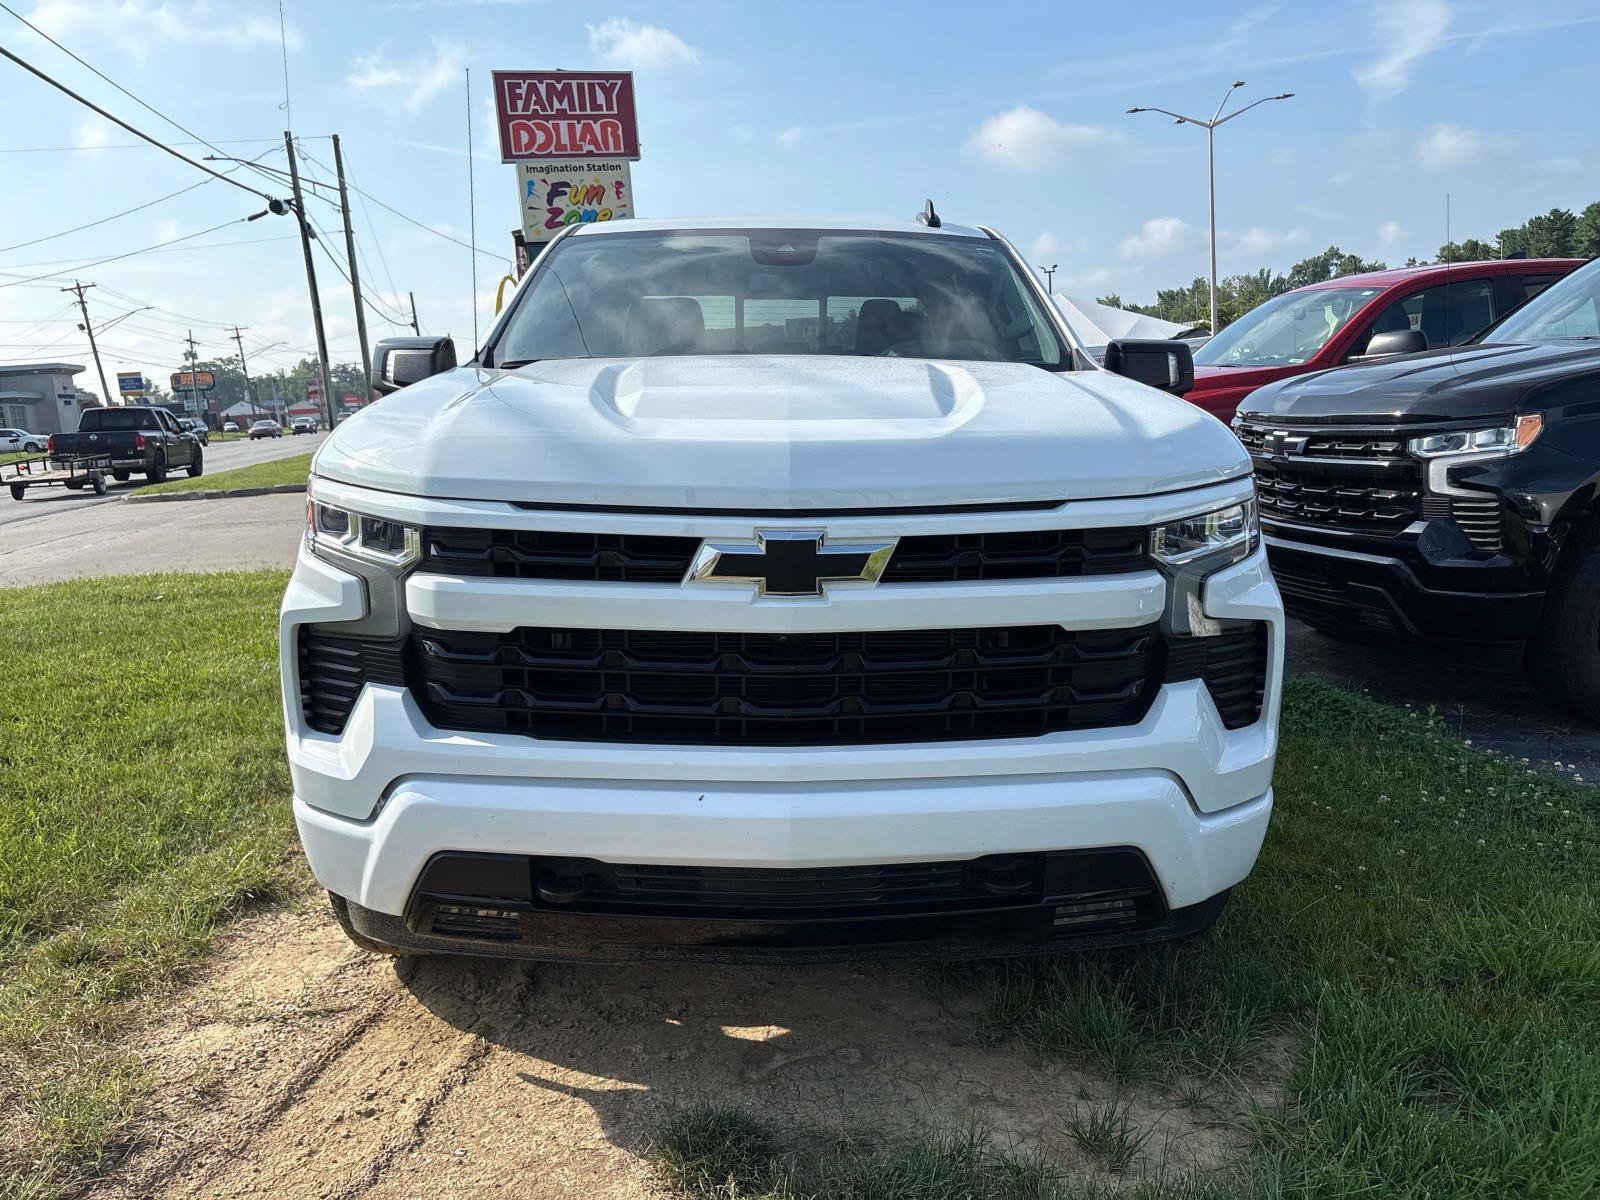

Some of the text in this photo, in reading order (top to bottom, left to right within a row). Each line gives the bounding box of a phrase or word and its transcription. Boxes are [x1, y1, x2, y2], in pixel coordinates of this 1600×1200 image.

[504, 80, 622, 114] FAMILY
[509, 119, 624, 155] DOLLAR
[526, 163, 622, 174] Imagination Station
[546, 181, 606, 207] Fun
[544, 207, 613, 230] Zone
